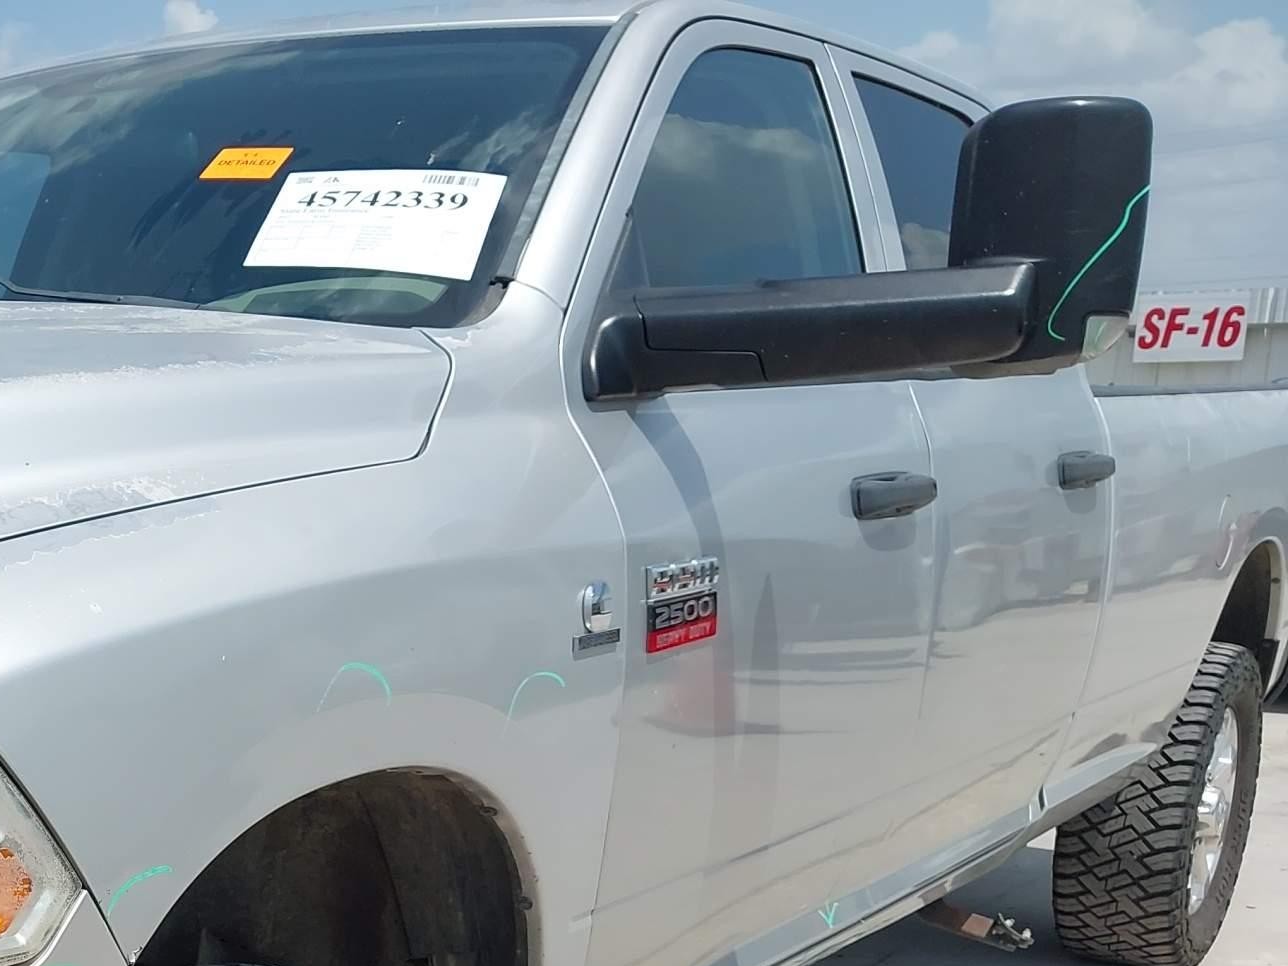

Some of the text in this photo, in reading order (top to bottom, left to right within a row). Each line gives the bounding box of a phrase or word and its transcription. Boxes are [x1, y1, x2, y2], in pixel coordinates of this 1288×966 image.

[297, 189, 469, 211] 45742339
[1137, 305, 1246, 350] SF-16
[655, 596, 713, 630] 2500
